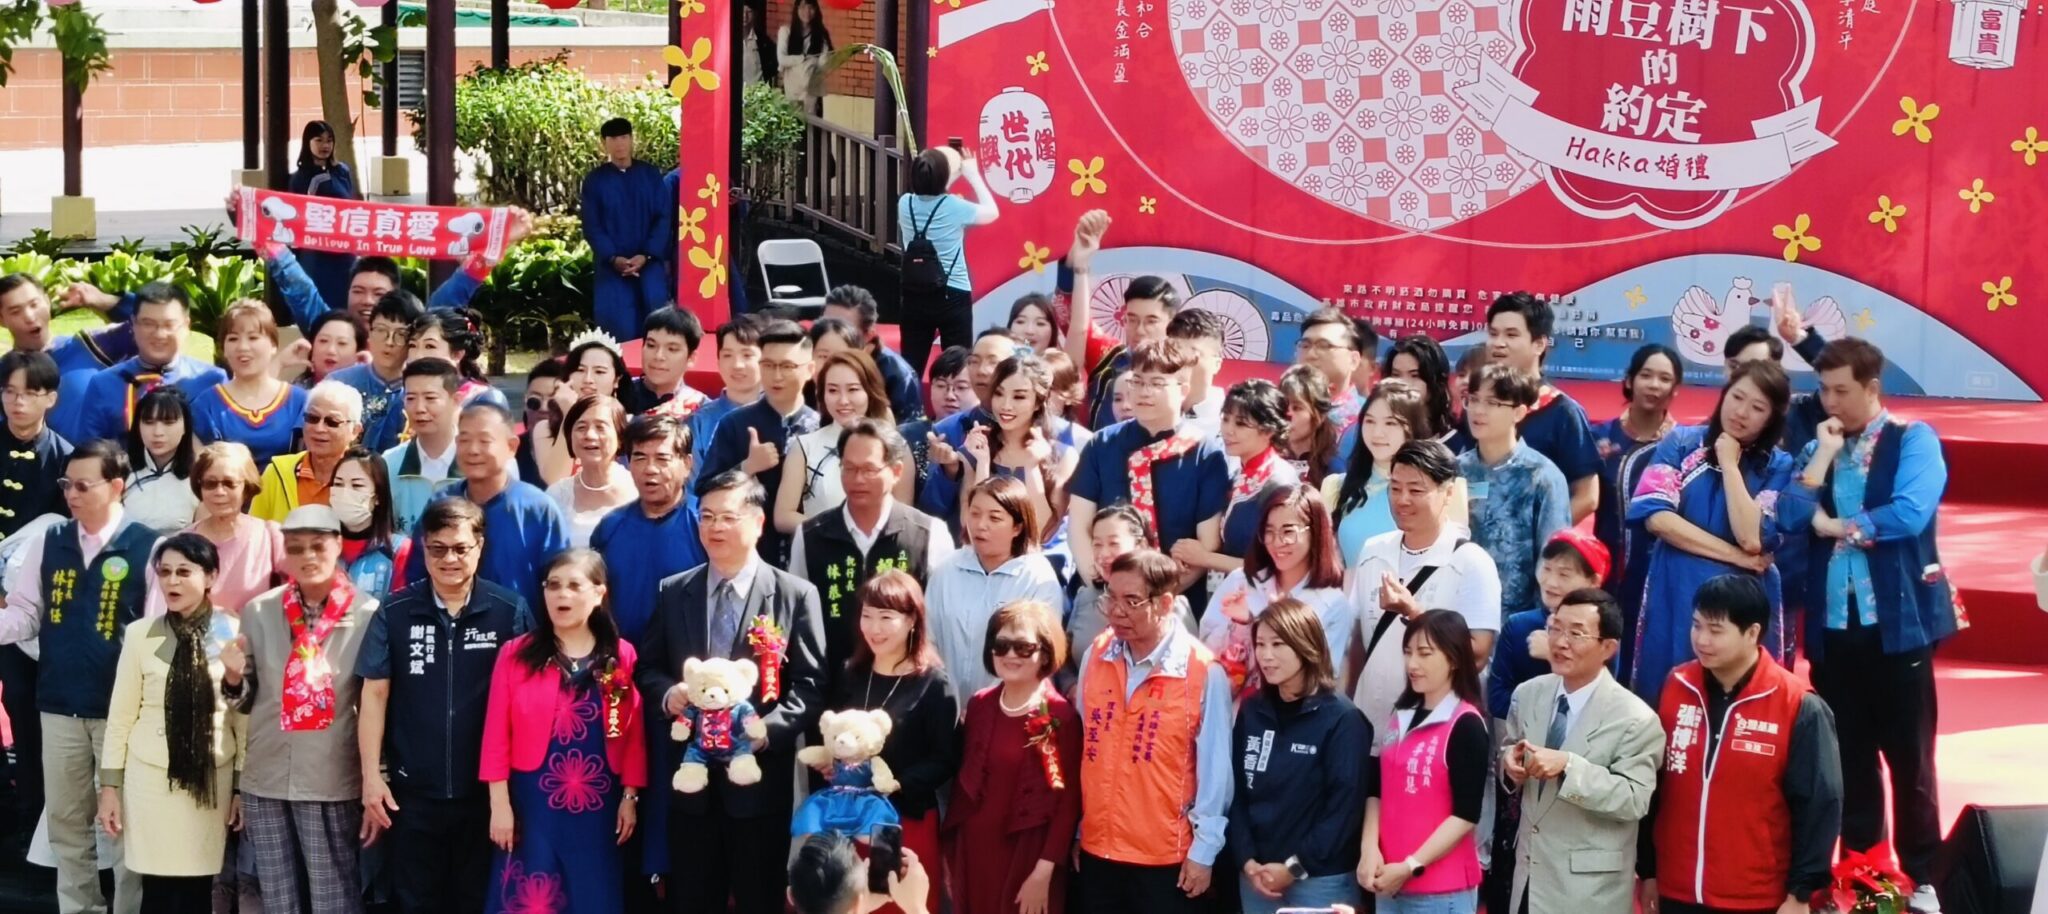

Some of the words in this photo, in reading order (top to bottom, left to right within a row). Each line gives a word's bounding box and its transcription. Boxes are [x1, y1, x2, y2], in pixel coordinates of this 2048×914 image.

[1562, 0, 1774, 54] 雨豆樹下
[1978, 8, 2003, 56] 富貴
[1641, 49, 1678, 86] 的
[1600, 82, 1707, 144] 約定
[1001, 110, 1035, 181] 世代
[304, 202, 440, 242] 堅信真愛
[356, 239, 370, 251] In
[376, 240, 404, 254] True
[409, 243, 437, 256] Love
[409, 625, 425, 675] 謝文斌
